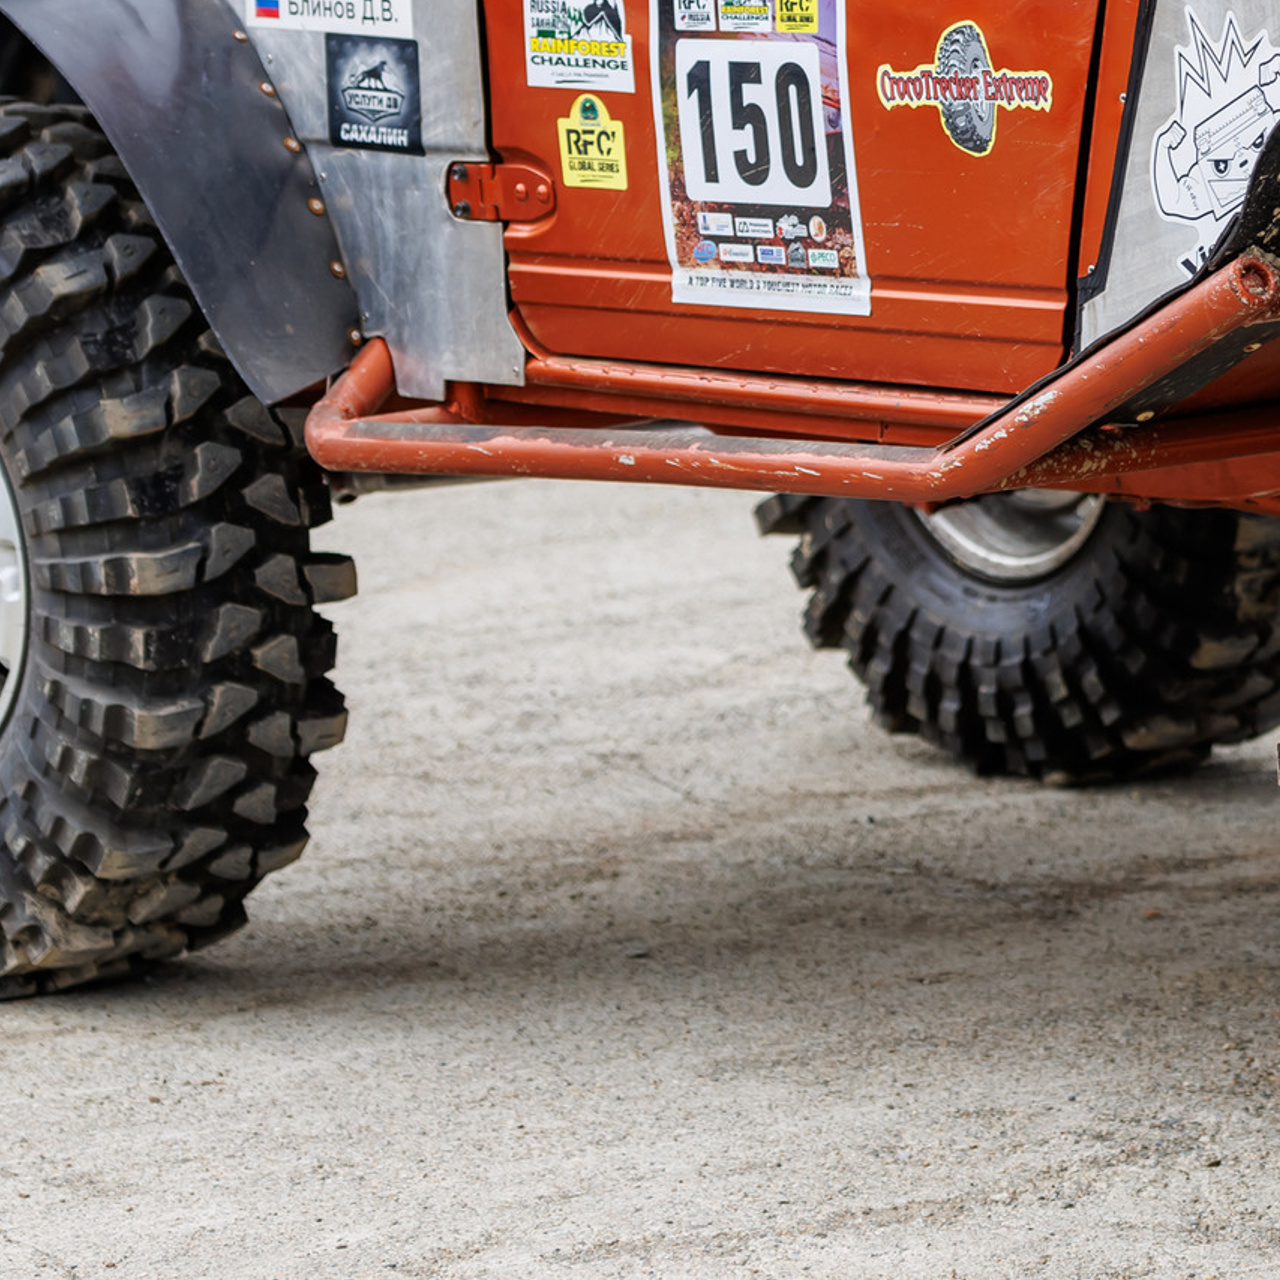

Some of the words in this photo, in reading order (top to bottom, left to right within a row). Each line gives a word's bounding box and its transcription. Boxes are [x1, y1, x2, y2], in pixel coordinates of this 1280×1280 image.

[530, 0, 568, 15] RUSSIA
[530, 37, 627, 58] RAINFOREST
[531, 54, 629, 71] CHALLENGE
[880, 70, 980, 102] CrocoTrecker
[981, 70, 1049, 105] Extreme
[347, 92, 383, 108] УСЛУГИ
[686, 60, 819, 189] 150
[340, 122, 409, 148] САХАЛИН
[568, 160, 596, 172] GLOBAL
[598, 162, 620, 174] SERIES
